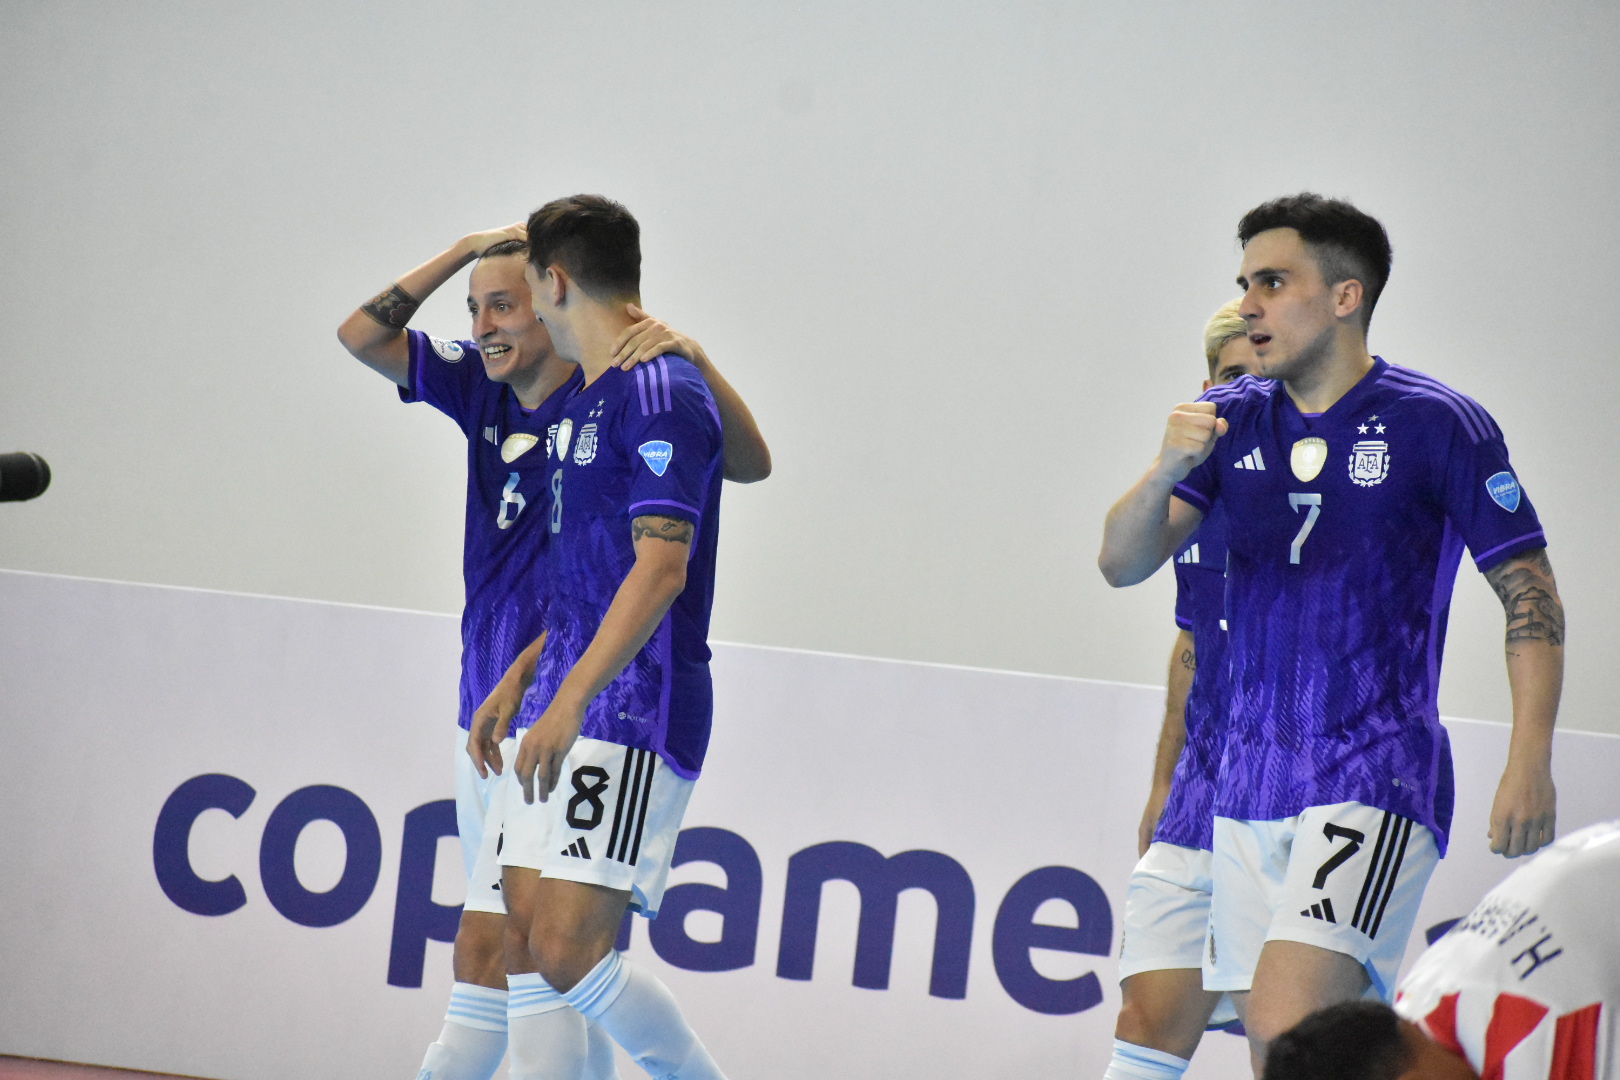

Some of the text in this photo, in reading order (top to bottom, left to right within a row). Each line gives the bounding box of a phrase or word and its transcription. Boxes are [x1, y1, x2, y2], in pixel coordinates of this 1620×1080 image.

[1357, 453, 1379, 473] AFA
[1493, 482, 1516, 495] VIBRA
[496, 472, 526, 530] 6
[1288, 493, 1321, 564] 7
[565, 765, 610, 830] 8
[1312, 822, 1365, 890] 7
